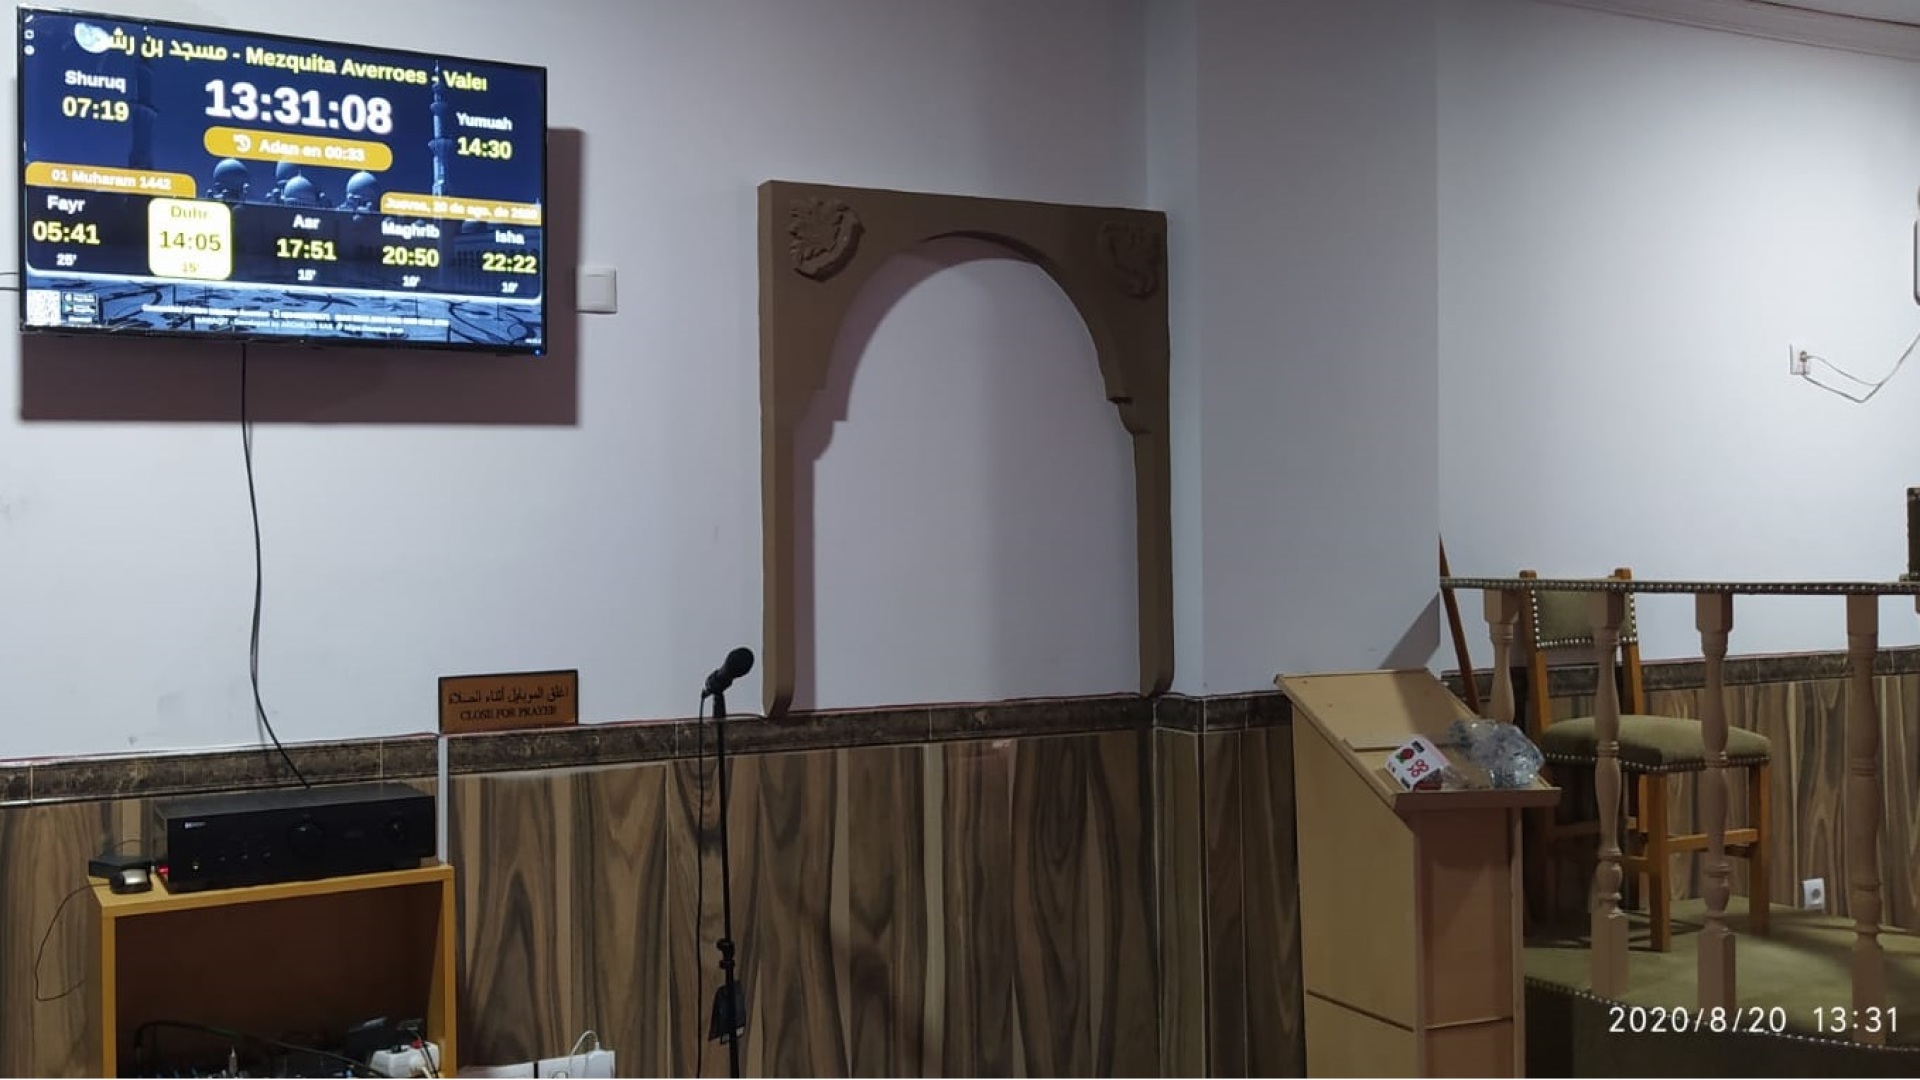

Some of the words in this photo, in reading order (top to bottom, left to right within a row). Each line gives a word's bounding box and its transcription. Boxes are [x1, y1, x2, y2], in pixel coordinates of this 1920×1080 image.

[169, 40, 228, 61] مسجد
[245, 46, 337, 75] Mezquita
[341, 59, 428, 84] Averroes
[64, 69, 127, 94] Shuruq
[62, 96, 130, 122] 07:19
[204, 78, 393, 135] 13:31:08
[455, 111, 513, 131] Yumuah
[457, 136, 513, 160] 14:30
[51, 168, 69, 183] 01
[72, 169, 137, 187] Muharam
[46, 195, 86, 214] Fayr
[170, 205, 208, 219] Duhr
[32, 220, 101, 245] 05:41
[160, 230, 222, 252] 14:05
[381, 220, 440, 240] Maghrib
[495, 229, 525, 246] Isha
[276, 237, 337, 261] 17:51
[382, 245, 440, 268] 20:50
[481, 252, 538, 275] 22:22
[460, 708, 494, 721] CLOSE
[496, 707, 516, 719] FOR
